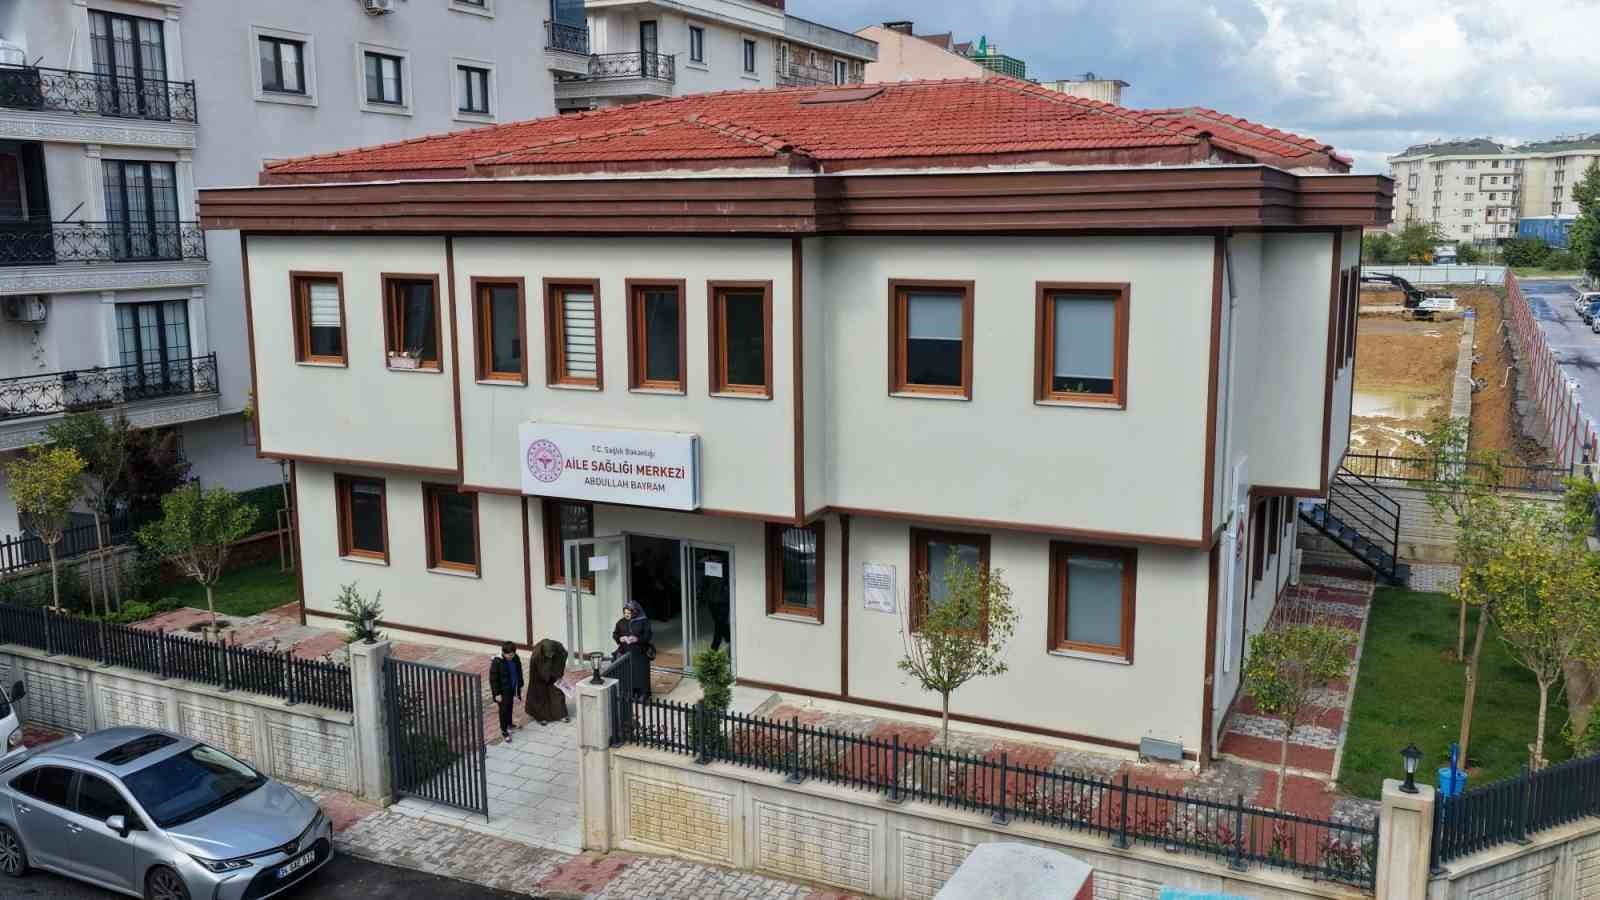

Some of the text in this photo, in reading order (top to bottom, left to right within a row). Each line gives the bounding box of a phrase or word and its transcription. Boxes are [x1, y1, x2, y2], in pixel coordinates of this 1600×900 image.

[565, 456, 685, 480] AİLE SAĞLIĞI MERKEZİ
[584, 476, 665, 493] ABDULLAH BAYRAM
